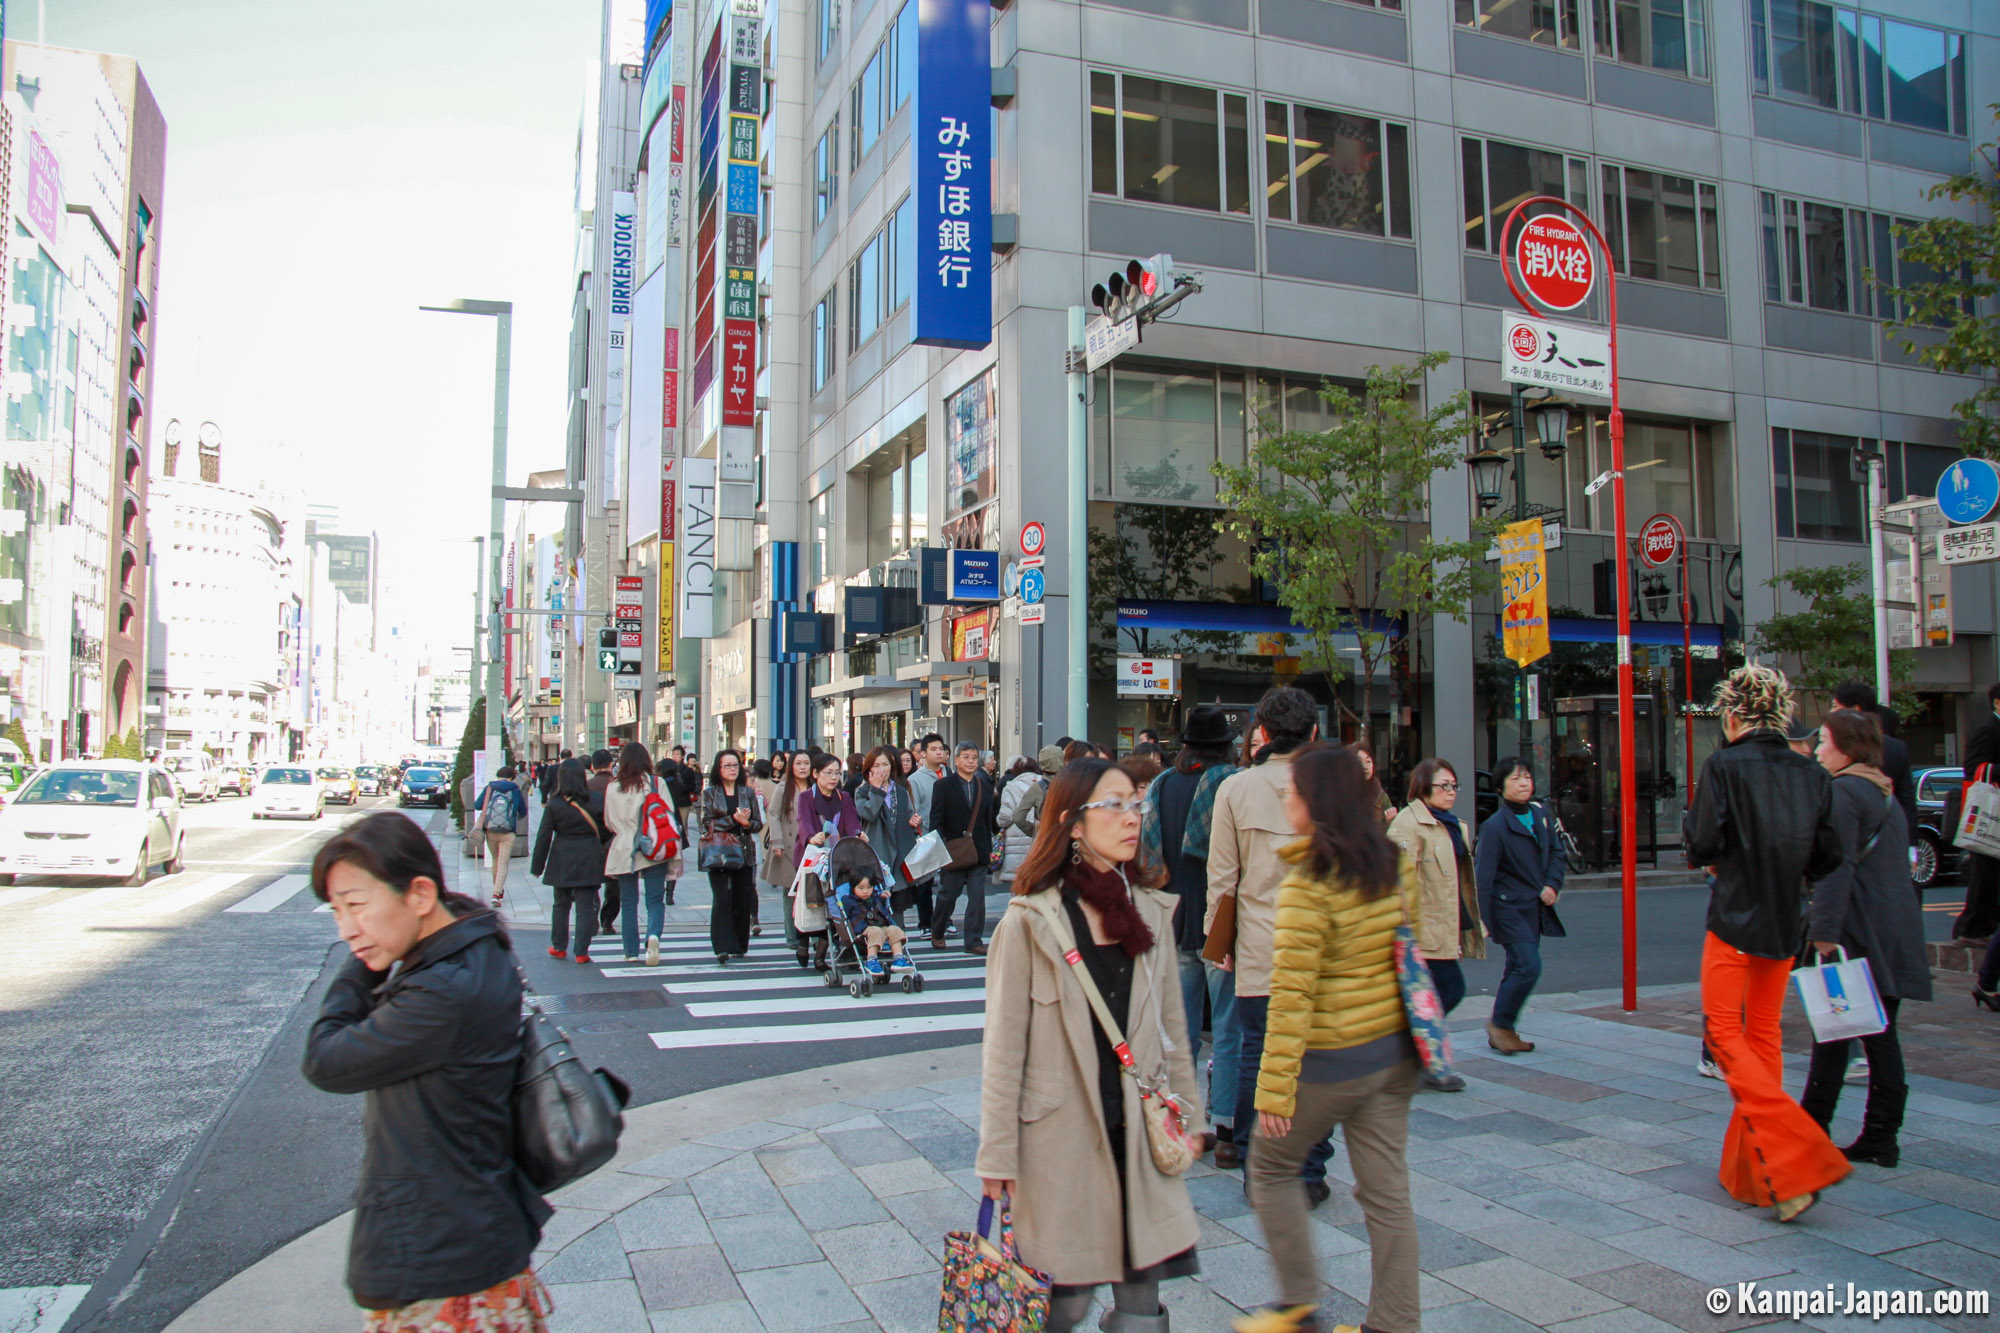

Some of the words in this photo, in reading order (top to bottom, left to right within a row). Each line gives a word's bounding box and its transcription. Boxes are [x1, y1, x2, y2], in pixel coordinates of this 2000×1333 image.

[740, 70, 749, 108] vivace
[735, 120, 754, 160] 歯科
[730, 167, 745, 211] 美容室
[938, 116, 972, 289] みずほ銀行
[1529, 225, 1545, 236] FIRE
[1547, 228, 1578, 242] HYDRANT
[612, 213, 633, 315] BIRKENSTOCK
[1524, 240, 1587, 283] 消火栓
[729, 282, 752, 316] 歯科
[728, 329, 752, 337] GINZA
[730, 340, 747, 405] ナカヤ
[664, 484, 672, 536] ワタベウェディング
[686, 485, 714, 610] FANCL
[1025, 530, 1039, 546] 30
[1648, 533, 1673, 552] 消火栓
[1943, 528, 1994, 546] 自転車通行可
[1943, 543, 1995, 560] ここから
[1025, 579, 1035, 600] P
[1031, 590, 1040, 600] 60
[1503, 563, 1542, 609] 2013
[1118, 607, 1148, 615] MIZUHO
[661, 616, 671, 656] びいどろ
